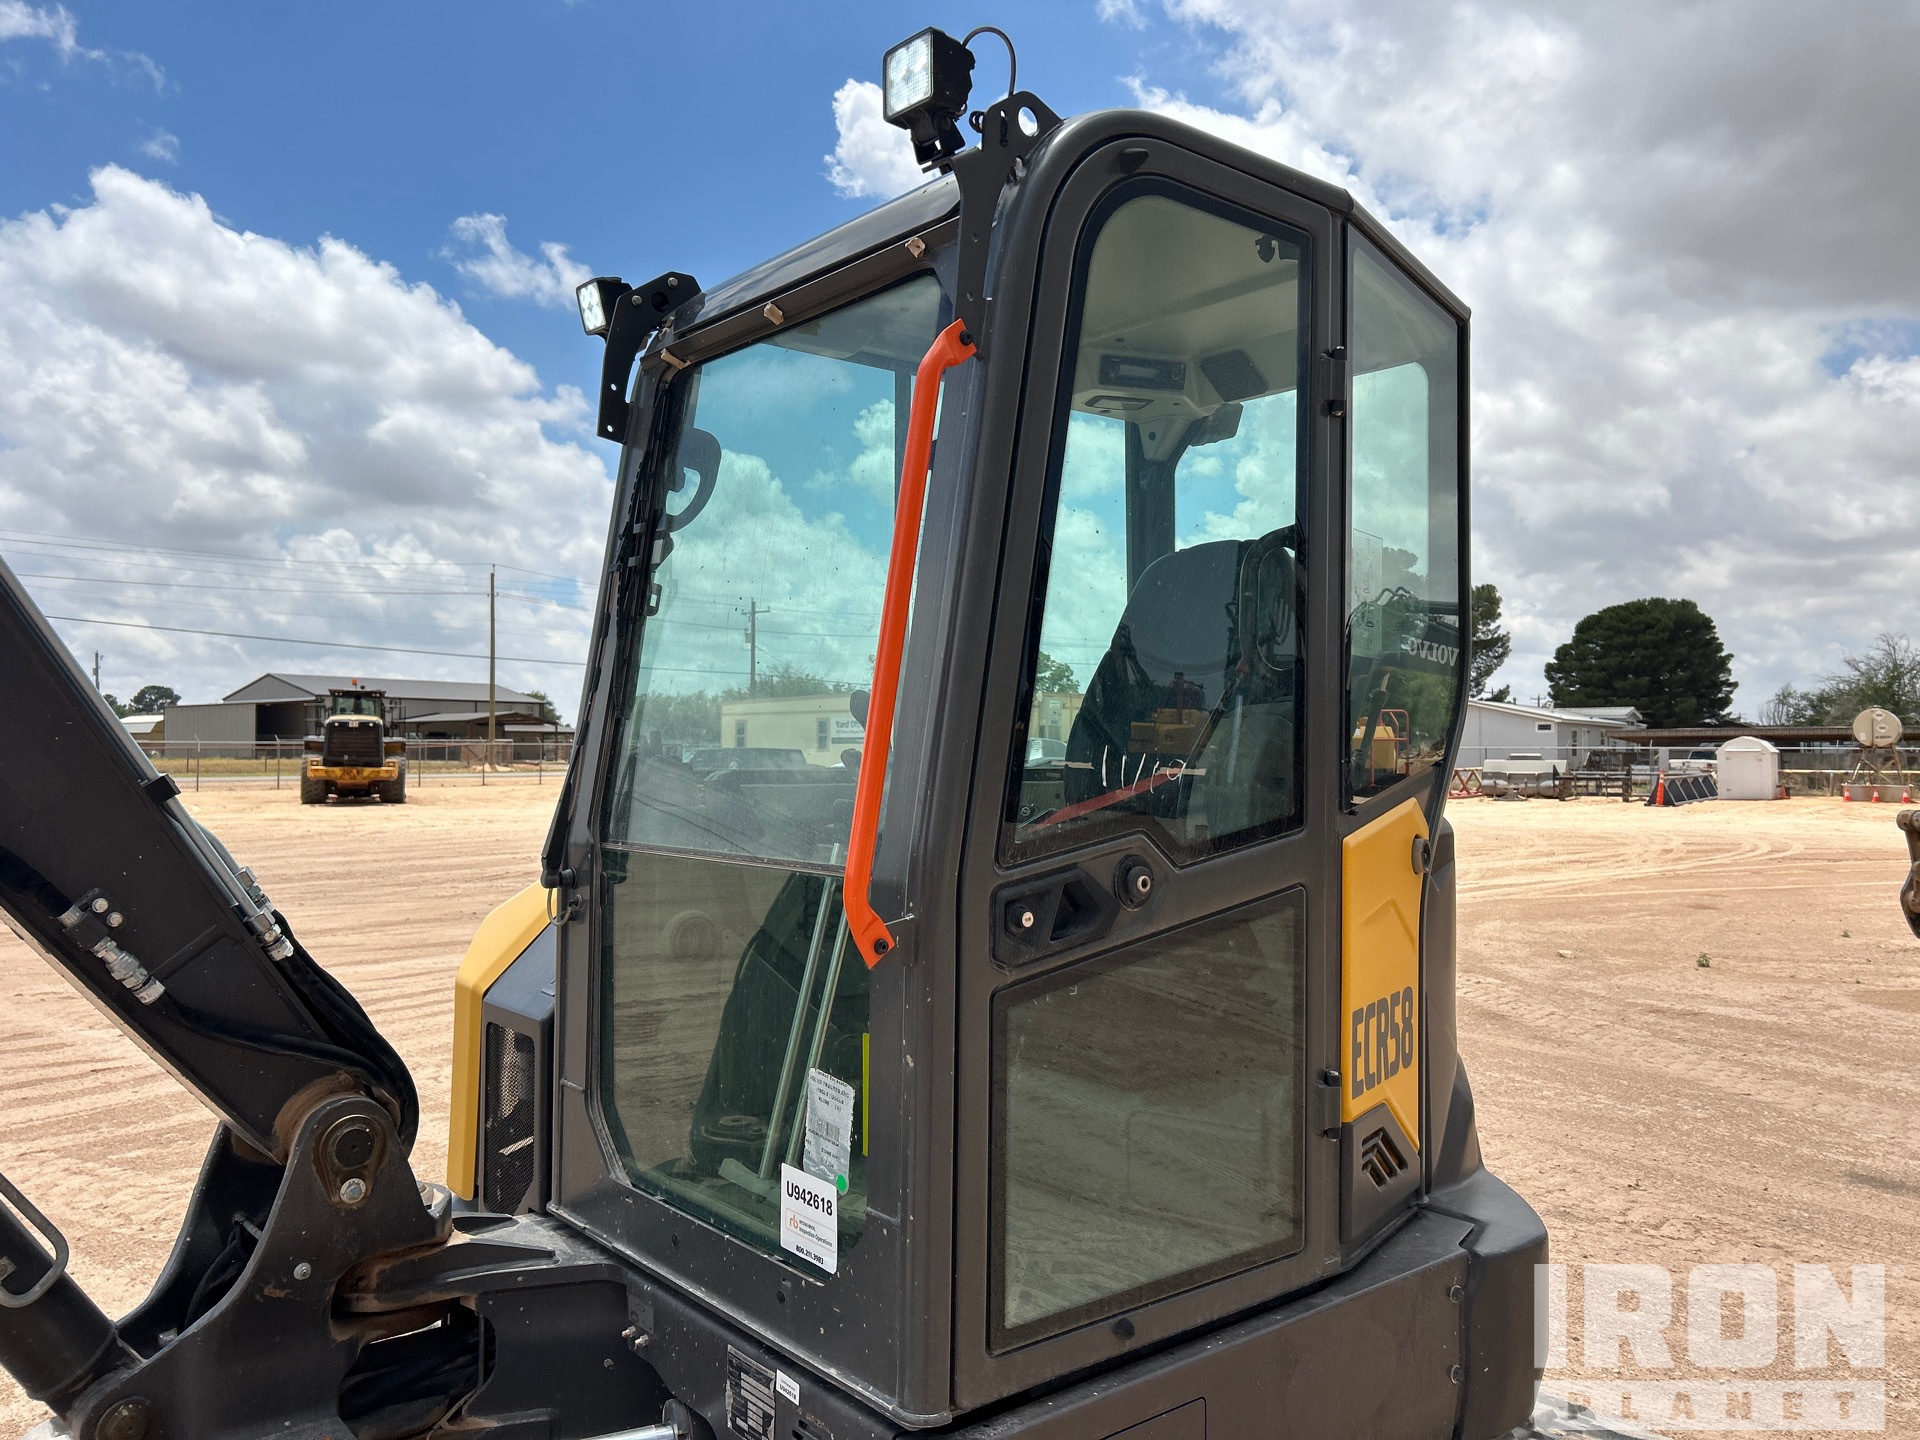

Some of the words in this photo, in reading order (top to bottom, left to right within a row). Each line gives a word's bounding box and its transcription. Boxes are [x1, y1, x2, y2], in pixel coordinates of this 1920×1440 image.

[836, 720, 849, 729] Yard
[1351, 986, 1414, 1100] ECR58
[786, 1181, 833, 1217] U942618
[815, 1234, 833, 1248] Operations
